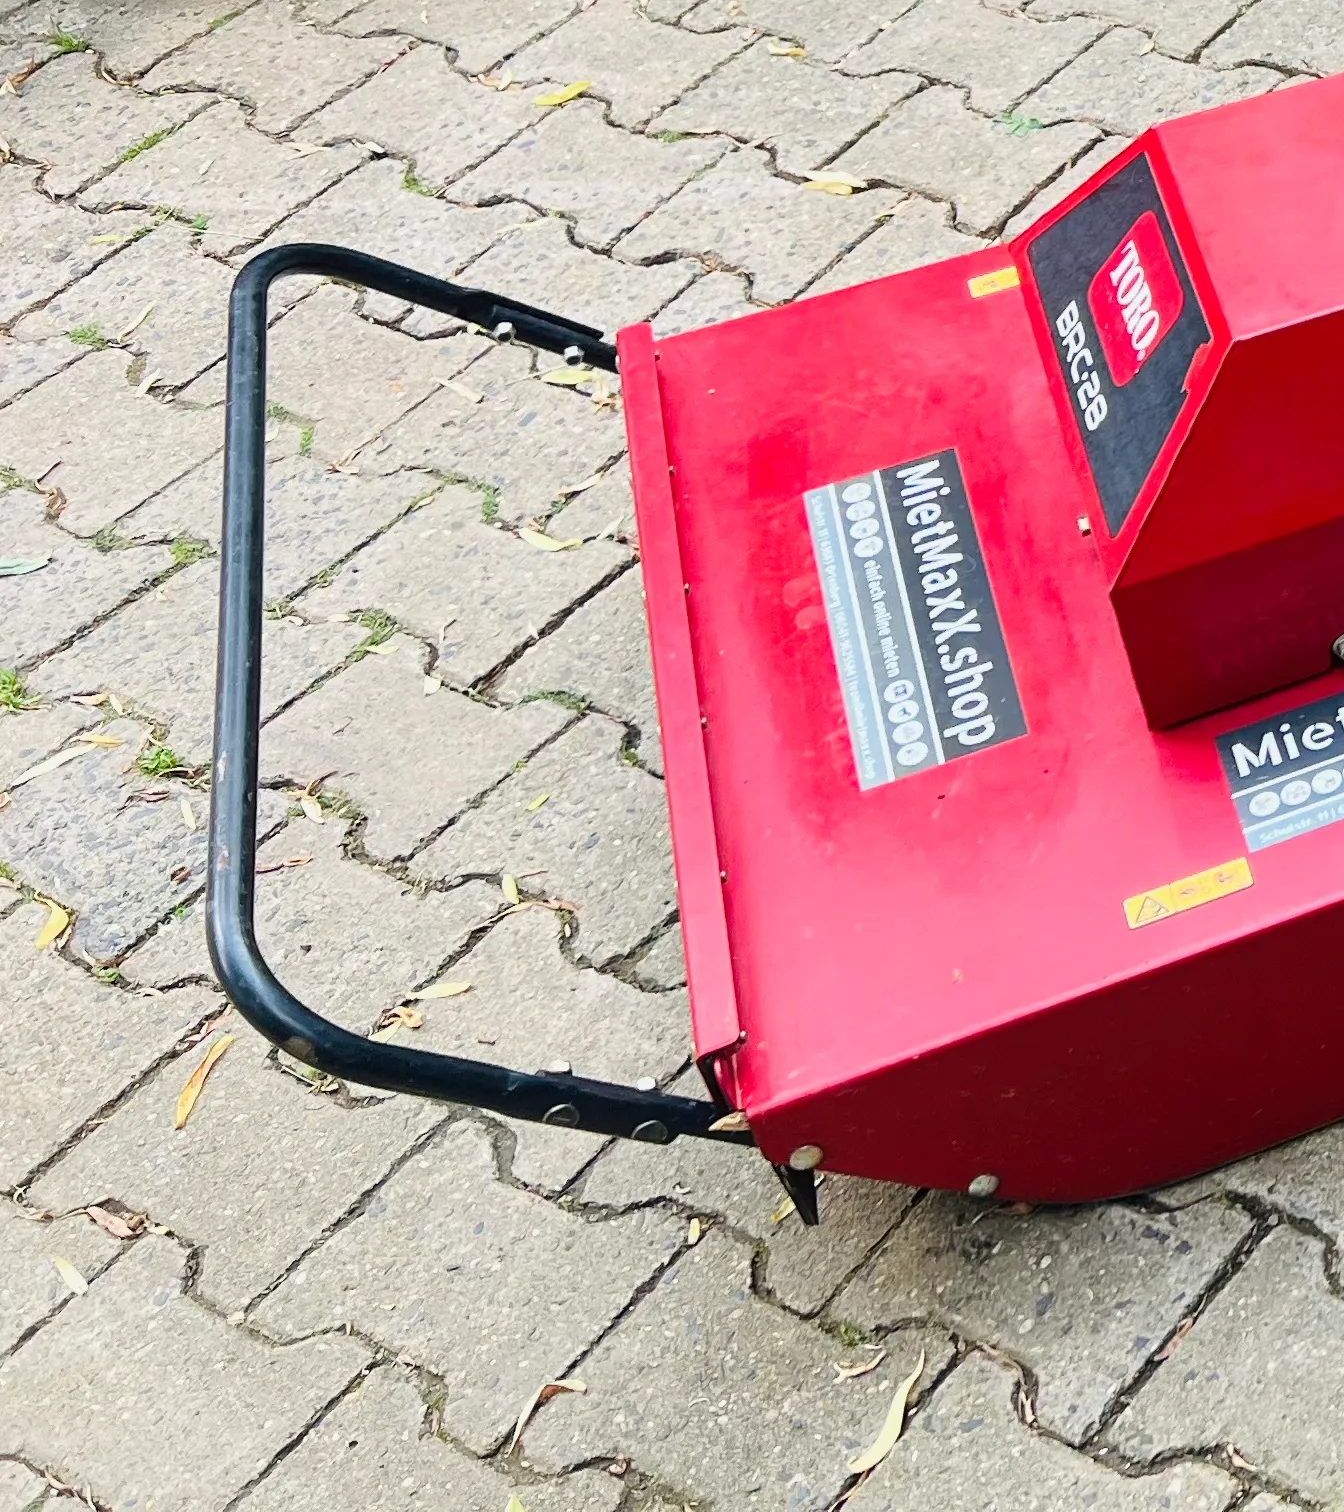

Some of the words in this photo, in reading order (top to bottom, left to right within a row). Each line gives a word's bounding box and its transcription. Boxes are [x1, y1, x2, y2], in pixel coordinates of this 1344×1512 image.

[863, 559, 886, 601] einfach
[872, 600, 892, 637] online
[896, 459, 996, 746] MietMaxX.shop
[881, 635, 900, 678] mieten
